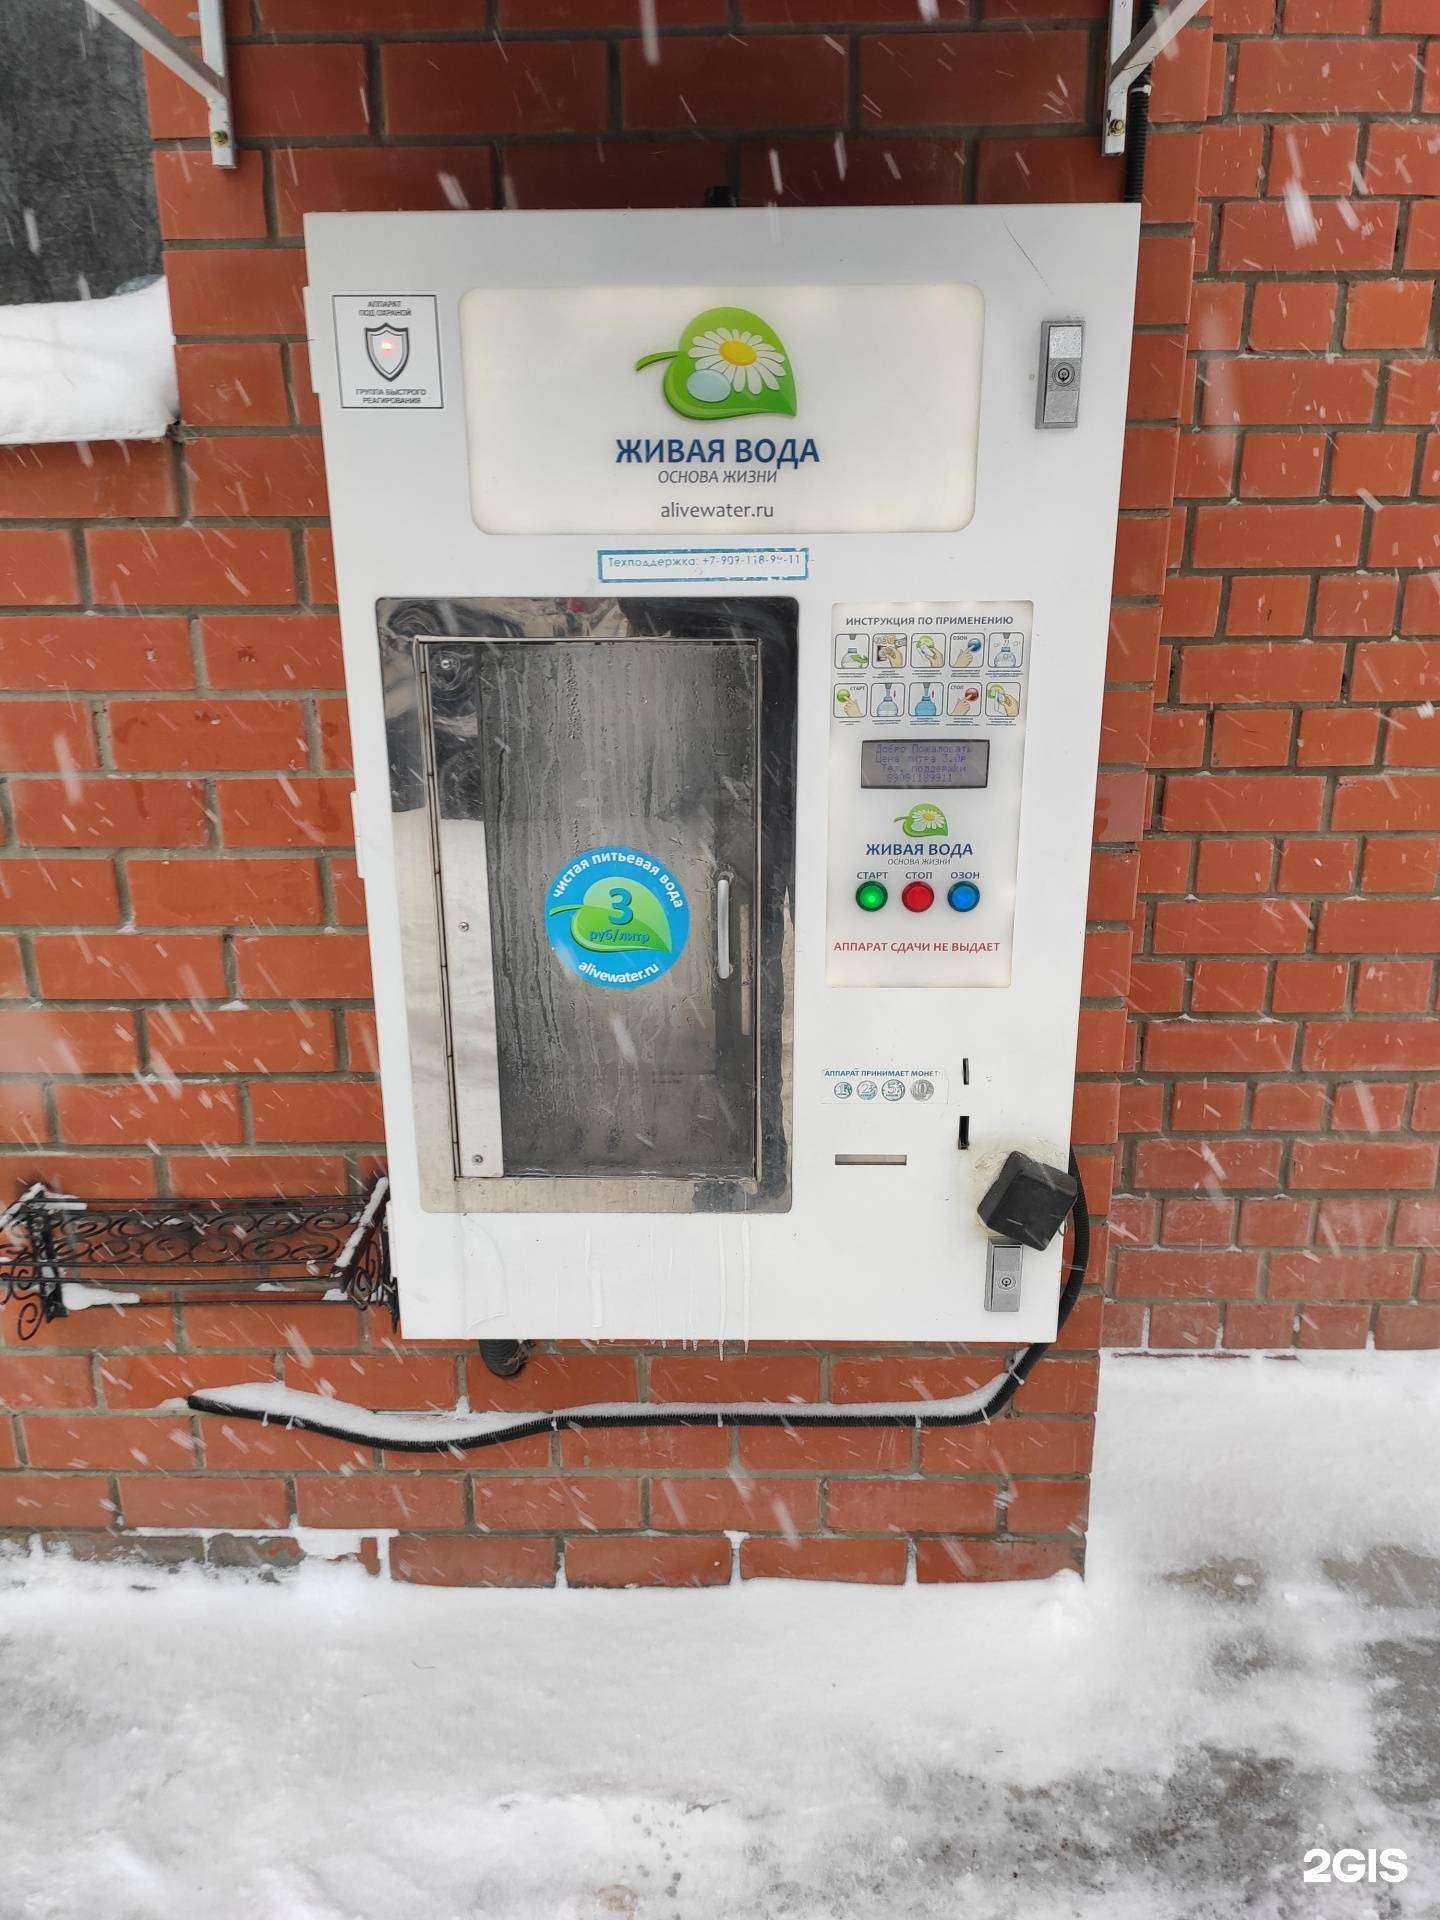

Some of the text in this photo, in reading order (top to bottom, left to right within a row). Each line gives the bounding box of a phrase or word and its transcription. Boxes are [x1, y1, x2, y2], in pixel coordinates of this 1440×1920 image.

[368, 300, 402, 308] АППАРАТ
[359, 308, 412, 317] ПОД ОХРАНОЙ
[355, 388, 427, 396] ГРУППА БЫСТРОГО
[616, 438, 820, 470] ЖИВАЯ ВОДА
[657, 470, 778, 484] ОСНОВА ЖИЗНИ
[660, 502, 774, 518] alivewater.ru
[846, 615, 1015, 628] ИНСТРУКЦИЯ ПО ПРИМЕНЕНИЮ
[866, 843, 974, 859] ЖИВАЯ ВОДА
[887, 858, 951, 866] ОСНОВА ЖИЗНИ
[553, 851, 684, 909] чистая питьевая вода
[856, 871, 888, 880] СТАРТ
[905, 871, 933, 880] СТОП
[950, 871, 980, 880] ОЗОН
[607, 887, 634, 926] 3
[589, 929, 651, 944] руб/литр
[834, 942, 1001, 954] АППАРАТ СДАЧИ НЕ ВЫДАЕТ
[578, 961, 660, 984] alivewater.ru
[824, 1069, 944, 1078] АППАРАТ ПРИНИМАЕТ МОНЕТ
